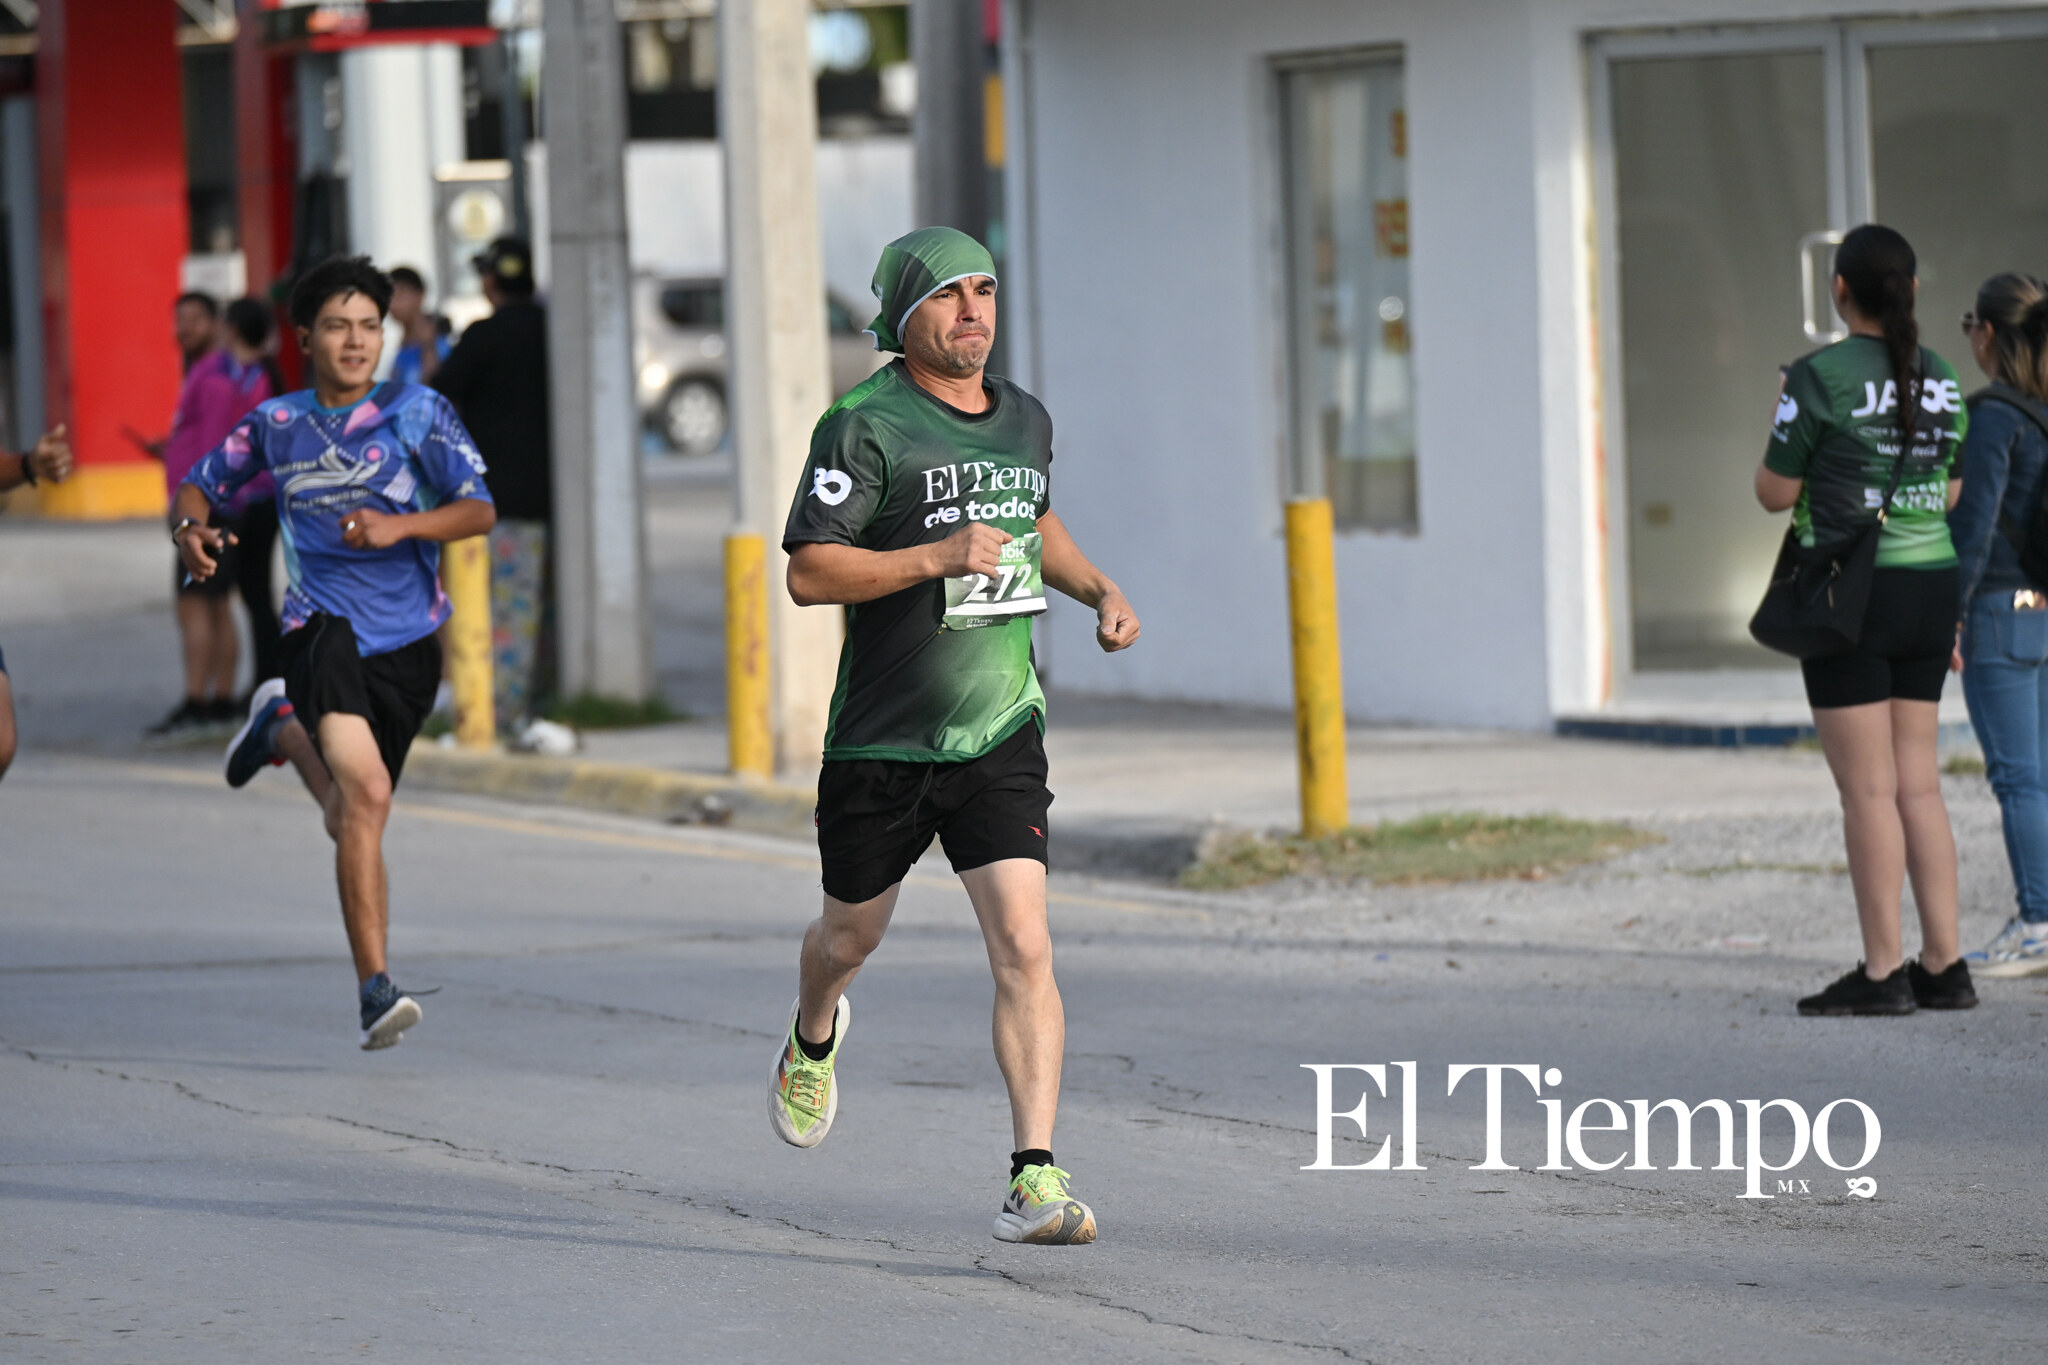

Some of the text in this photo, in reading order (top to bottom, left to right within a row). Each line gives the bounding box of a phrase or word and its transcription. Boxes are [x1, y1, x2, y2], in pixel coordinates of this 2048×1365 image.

[921, 461, 1047, 503] El Tiempo
[924, 496, 1036, 528] de todos
[963, 563, 1032, 603] 272
